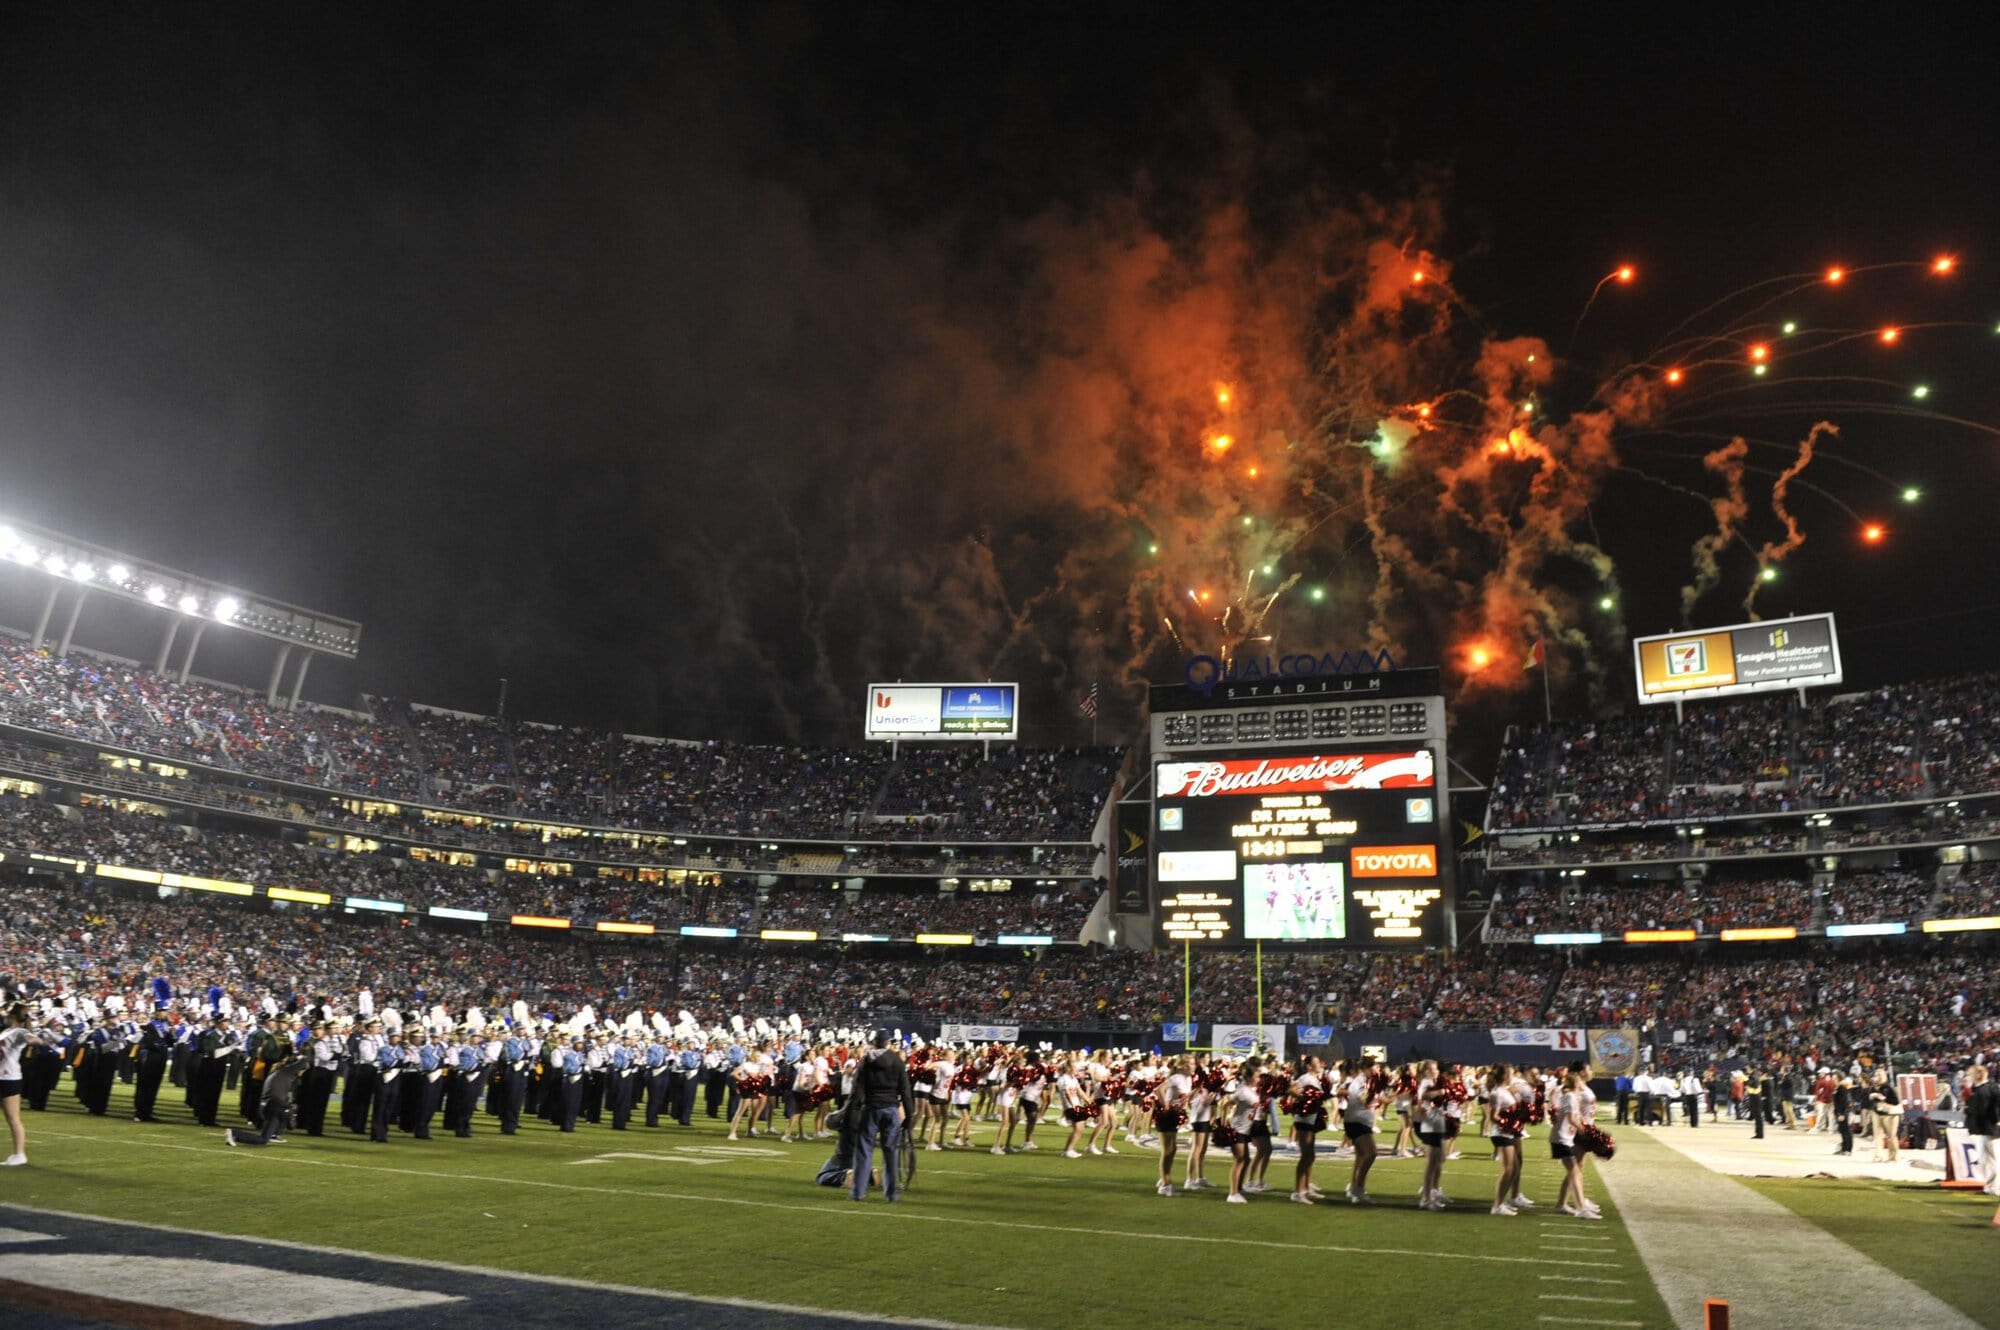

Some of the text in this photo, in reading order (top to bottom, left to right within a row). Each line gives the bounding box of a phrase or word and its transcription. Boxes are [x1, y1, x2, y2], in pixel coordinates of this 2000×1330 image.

[1736, 645, 1830, 663] Imaging Healthcare
[1184, 648, 1396, 697] QUALCOMM
[1228, 678, 1380, 697] STADIUM
[1186, 756, 1365, 797] Budweiser
[1355, 853, 1432, 870] TOYOTA
[1558, 1031, 1578, 1049] N
